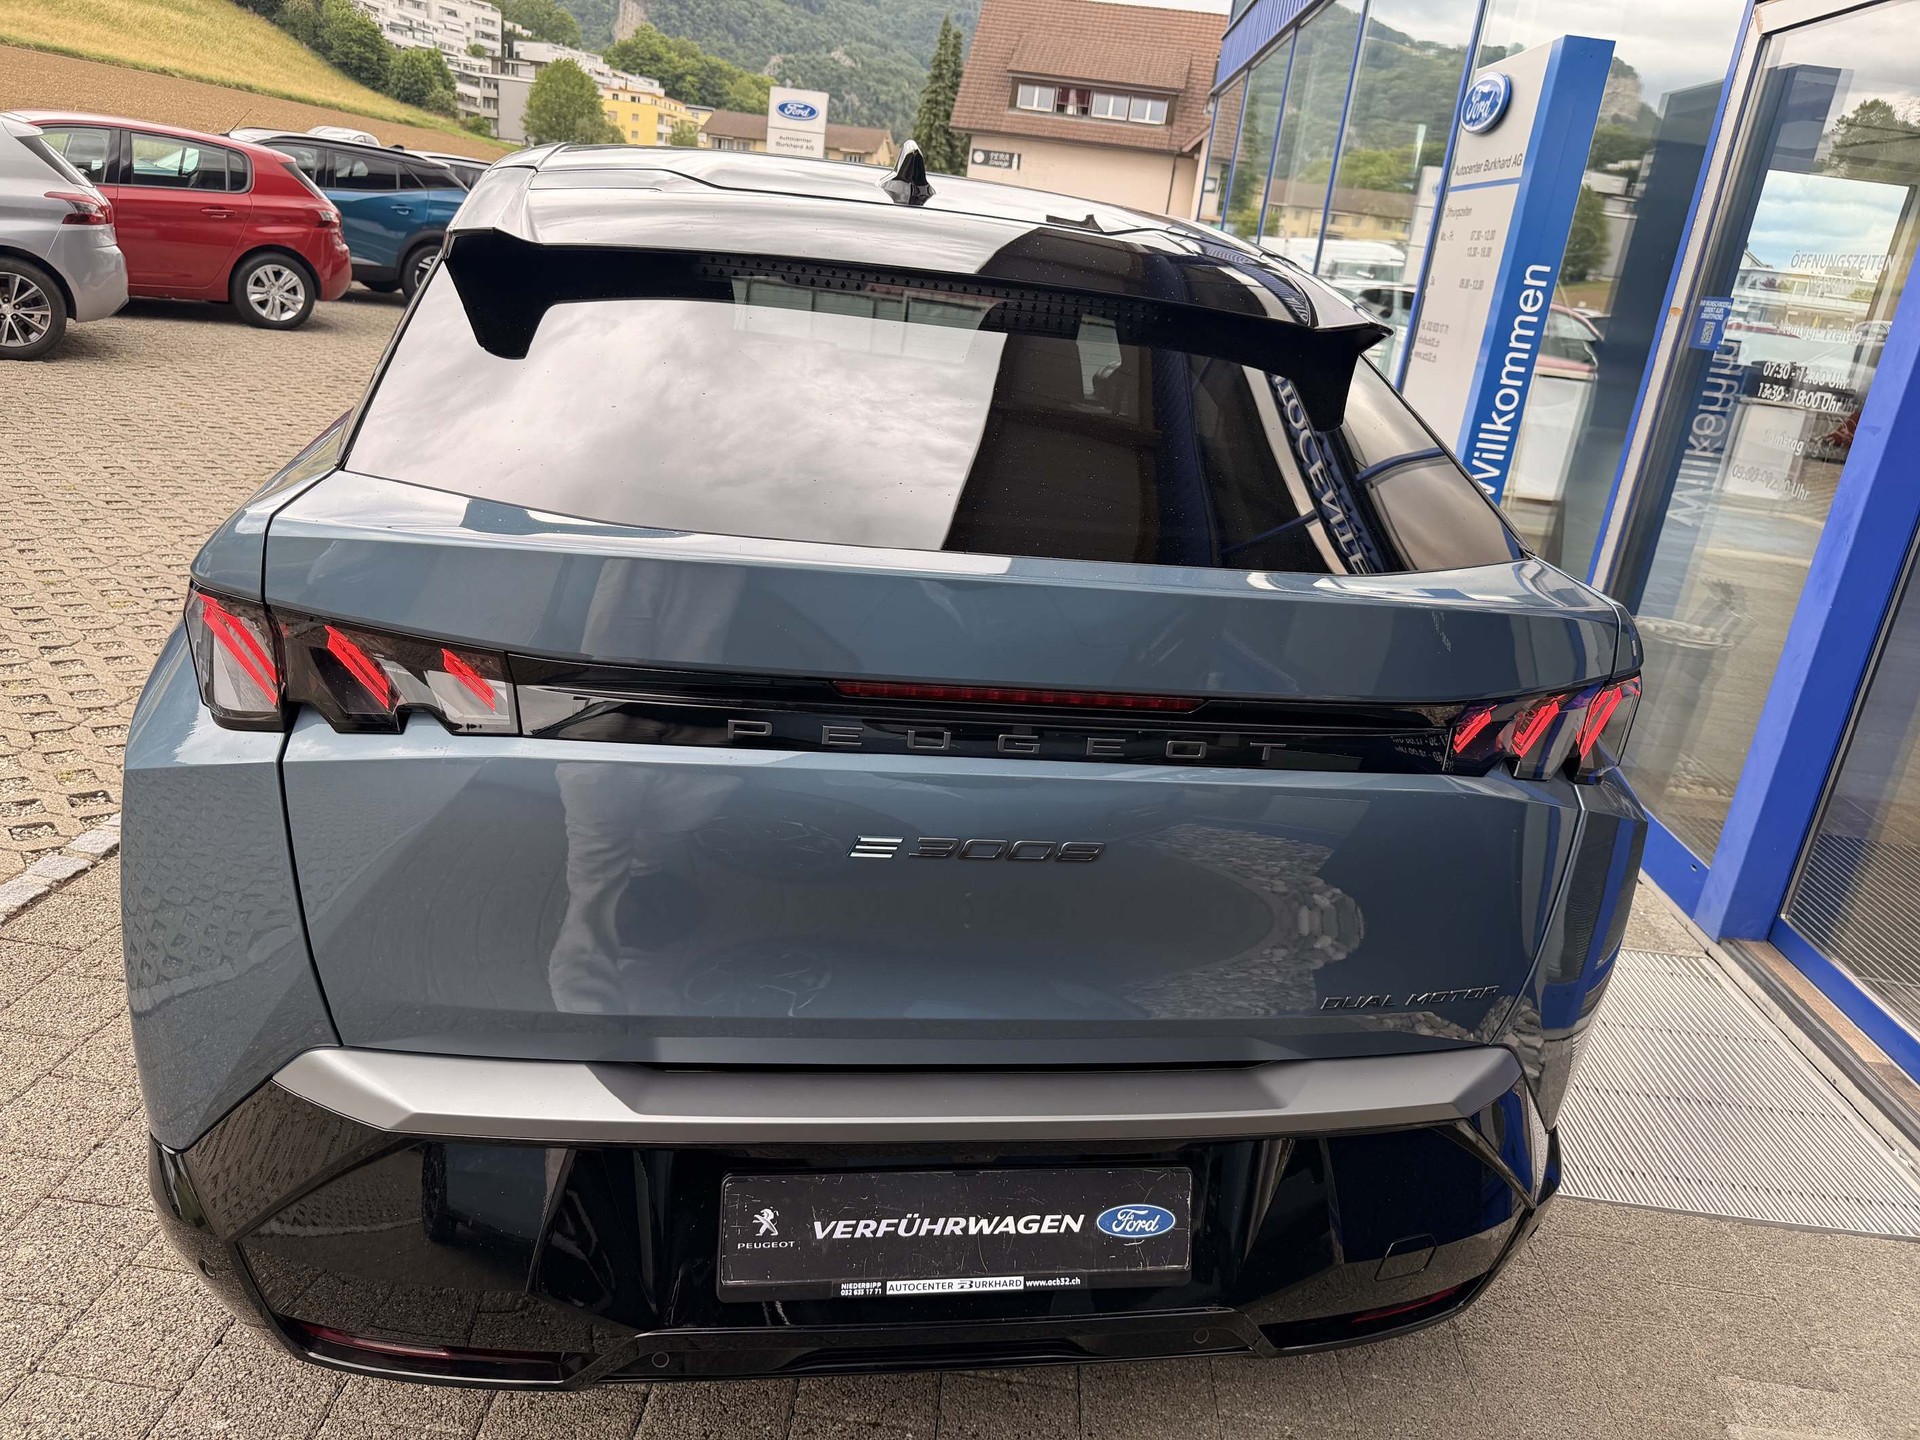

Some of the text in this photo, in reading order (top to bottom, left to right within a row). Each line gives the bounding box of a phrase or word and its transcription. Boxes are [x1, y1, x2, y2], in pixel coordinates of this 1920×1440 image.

[1455, 153, 1523, 176] Autocenter Burkhard AG
[1790, 250, 1896, 271] ÖFFNUNGSZEITEN
[1472, 264, 1551, 495] Willkommen
[1763, 362, 1791, 380] 07:30
[1821, 392, 1842, 412] Uhr
[1791, 482, 1810, 501] Uhr
[727, 719, 1286, 761] PEUGEOT
[908, 836, 1104, 862] 3008
[1320, 985, 1500, 1010] DUAL MOTOR
[813, 1213, 1085, 1240] VERFÜHRWAGEN
[737, 1240, 796, 1250] PEUGEOT
[841, 1281, 882, 1290] NIEDERBIPP
[888, 1279, 1022, 1292] AUTOCENTER BURKHARD
[1025, 1277, 1081, 1287] www.acb32.ch
